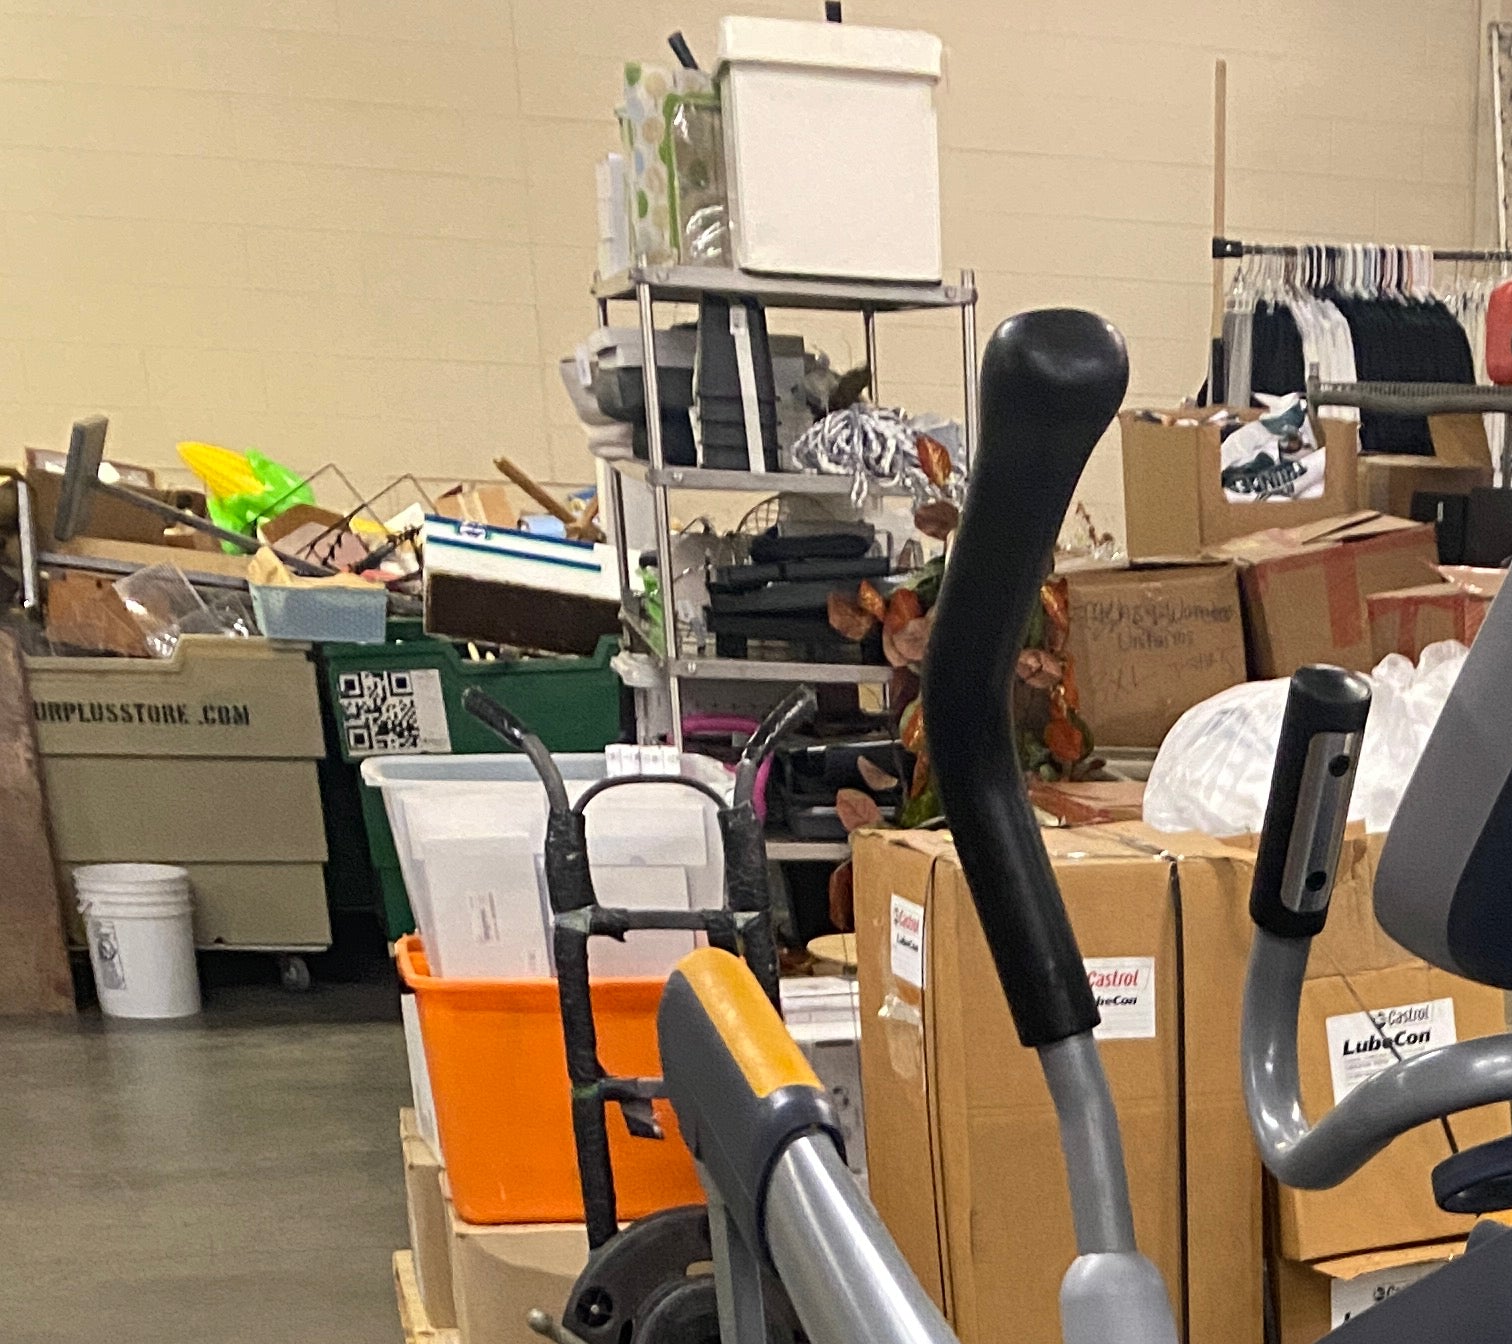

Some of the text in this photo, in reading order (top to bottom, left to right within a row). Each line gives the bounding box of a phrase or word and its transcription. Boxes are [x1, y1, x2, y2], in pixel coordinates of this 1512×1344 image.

[34, 700, 189, 725] URPLUSSTORE
[1087, 969, 1139, 988] Castrol
[1096, 994, 1138, 1007] beCon
[1387, 1004, 1430, 1026] Castrol
